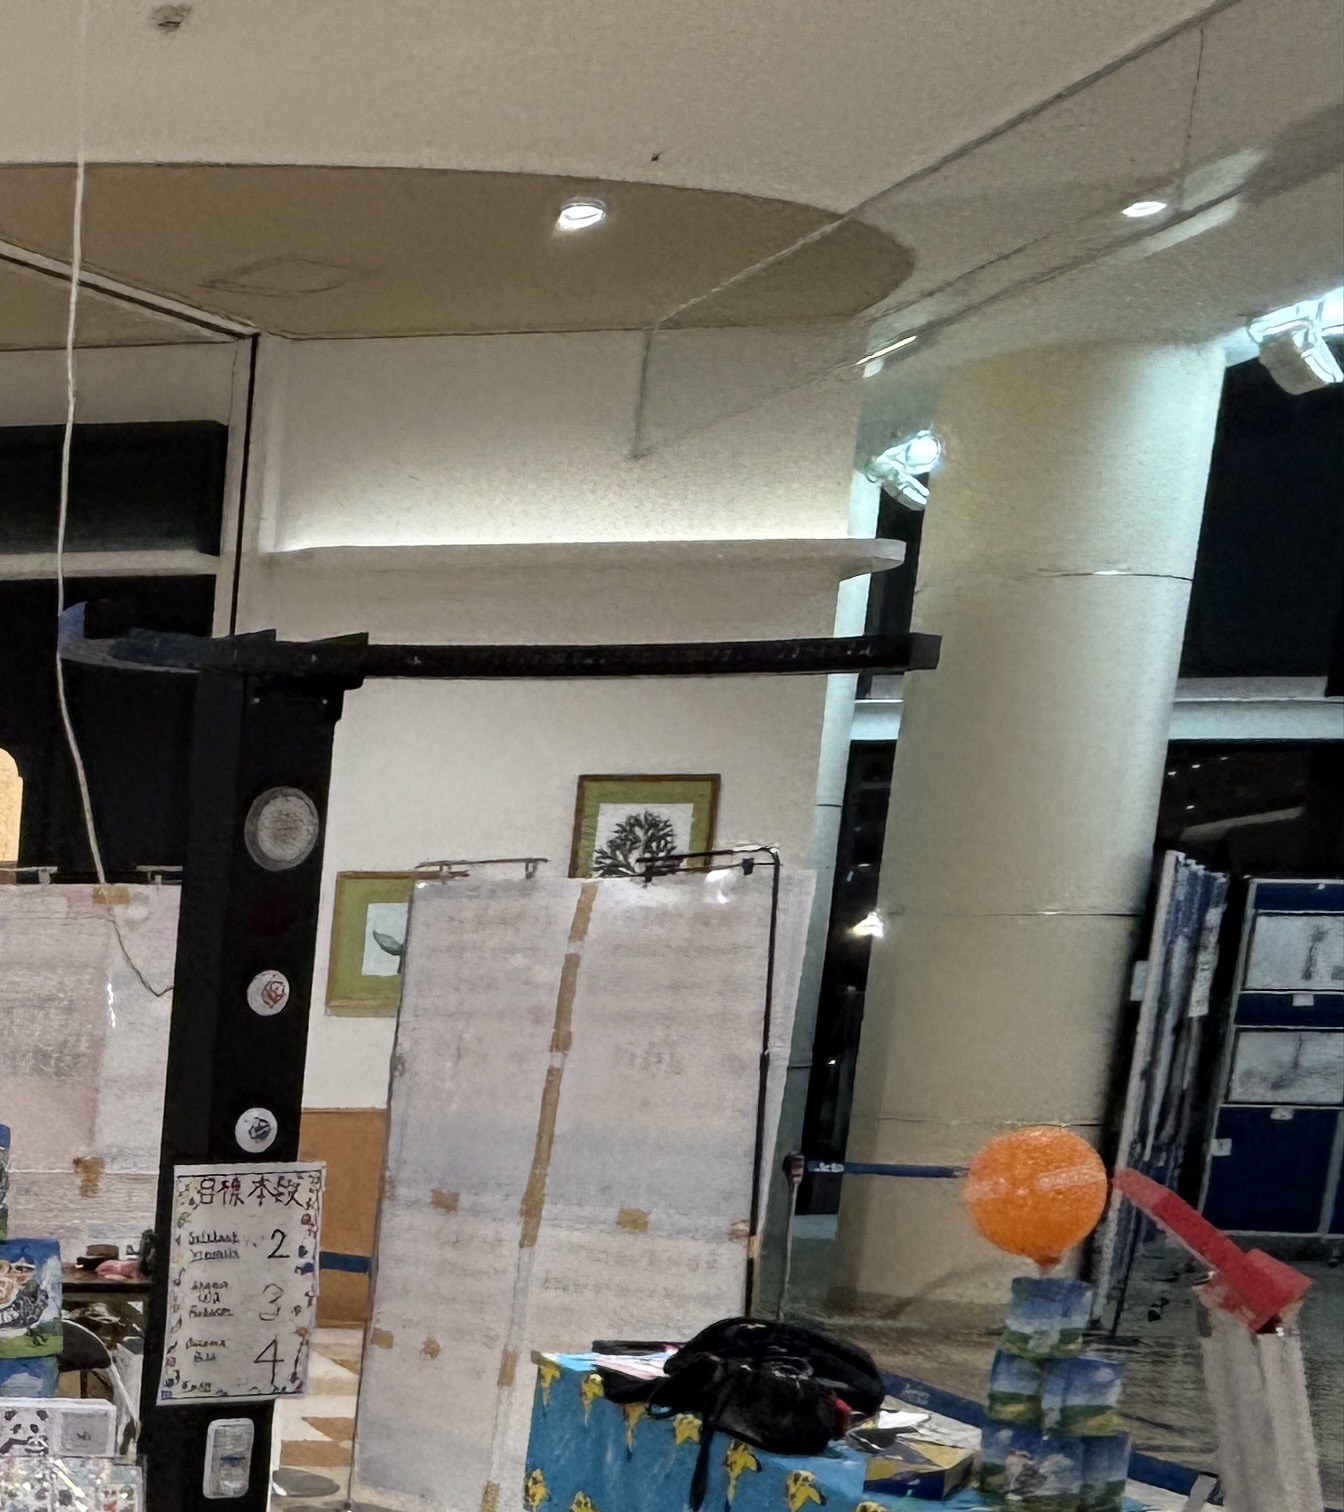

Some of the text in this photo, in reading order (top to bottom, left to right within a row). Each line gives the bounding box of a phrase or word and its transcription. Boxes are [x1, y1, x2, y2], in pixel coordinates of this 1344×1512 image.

[267, 1228, 290, 1259] 2
[259, 1282, 285, 1322] 3
[253, 1337, 285, 1386] 4
